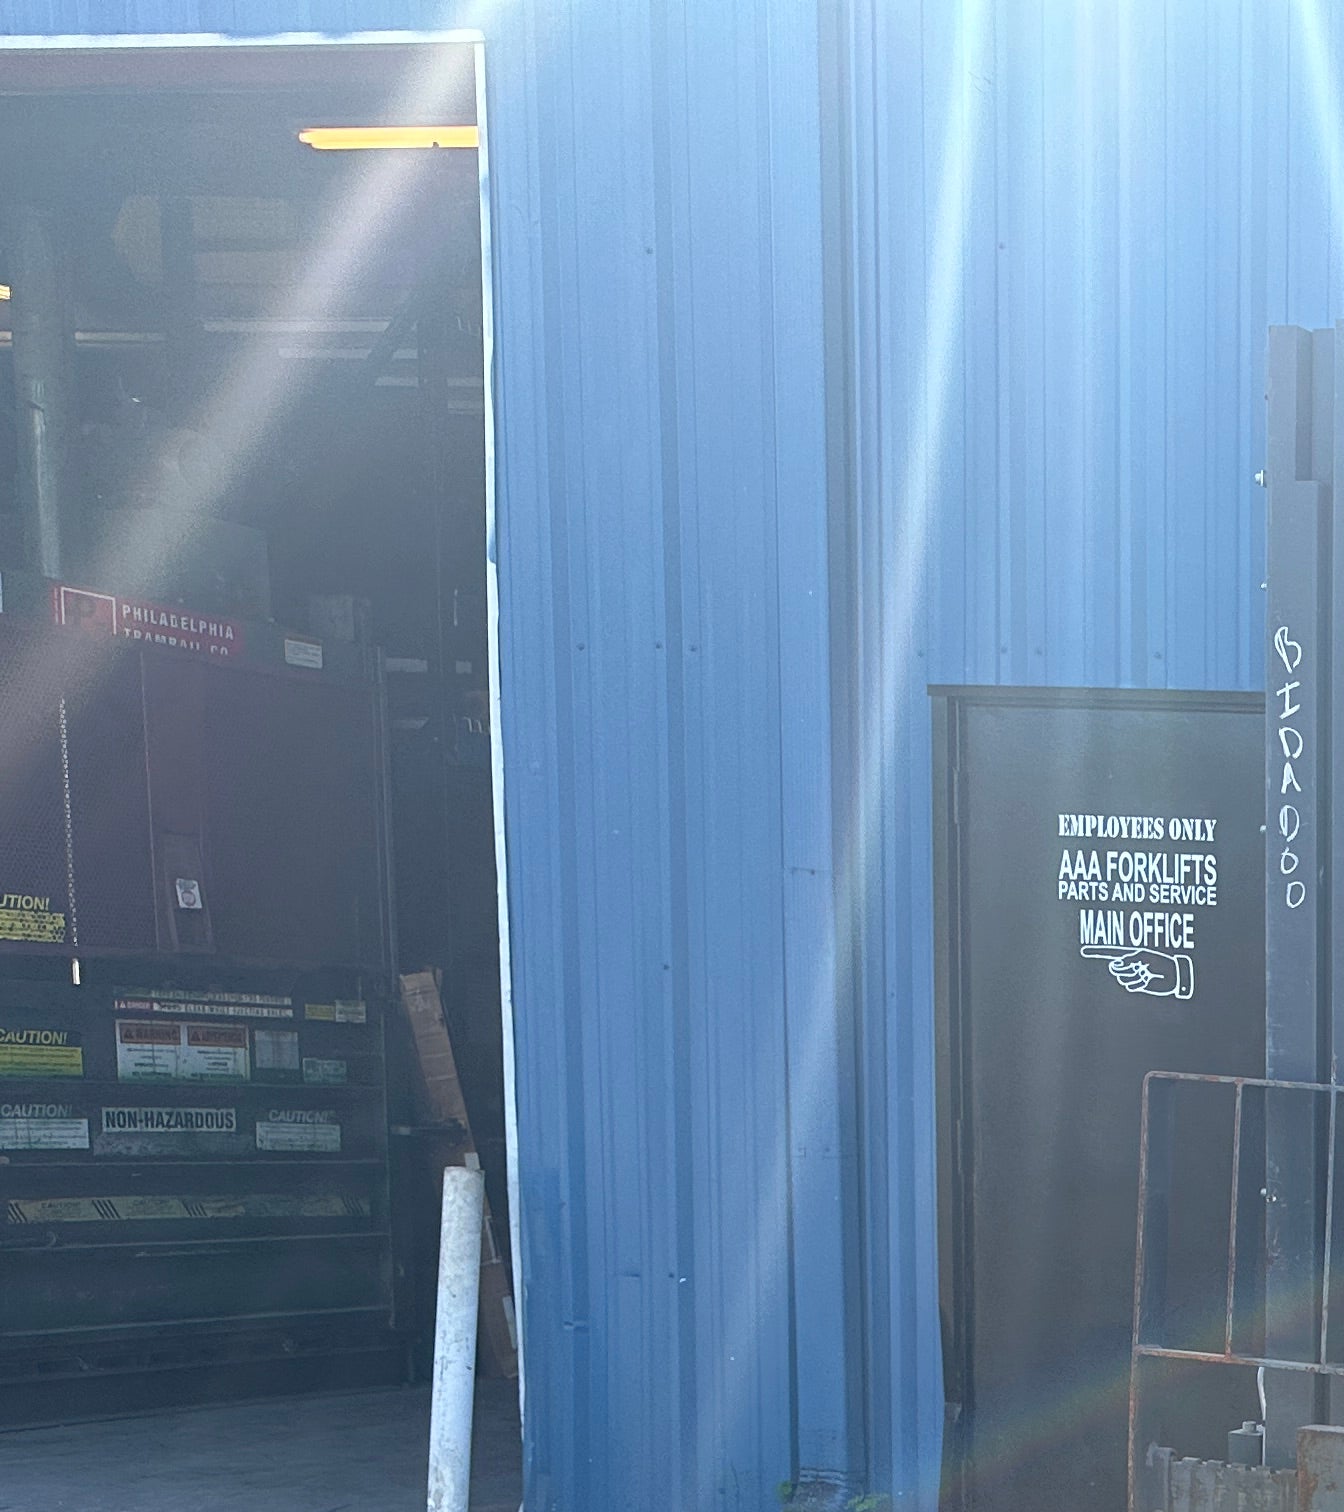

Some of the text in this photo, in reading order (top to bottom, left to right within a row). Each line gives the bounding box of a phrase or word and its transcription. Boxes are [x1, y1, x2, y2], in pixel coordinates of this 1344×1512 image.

[122, 604, 235, 641] PHILADELPHIA
[1058, 814, 1217, 842] EMPLOYEES ONLY
[1058, 850, 1217, 885] AAA FORKLIFTS
[1058, 881, 1217, 905] PARTS AND SERVICE
[1080, 909, 1194, 948] MAIN OFFICE
[1, 1103, 73, 1118] CAUTION!
[105, 1110, 234, 1129] NON-HAZARDOUS
